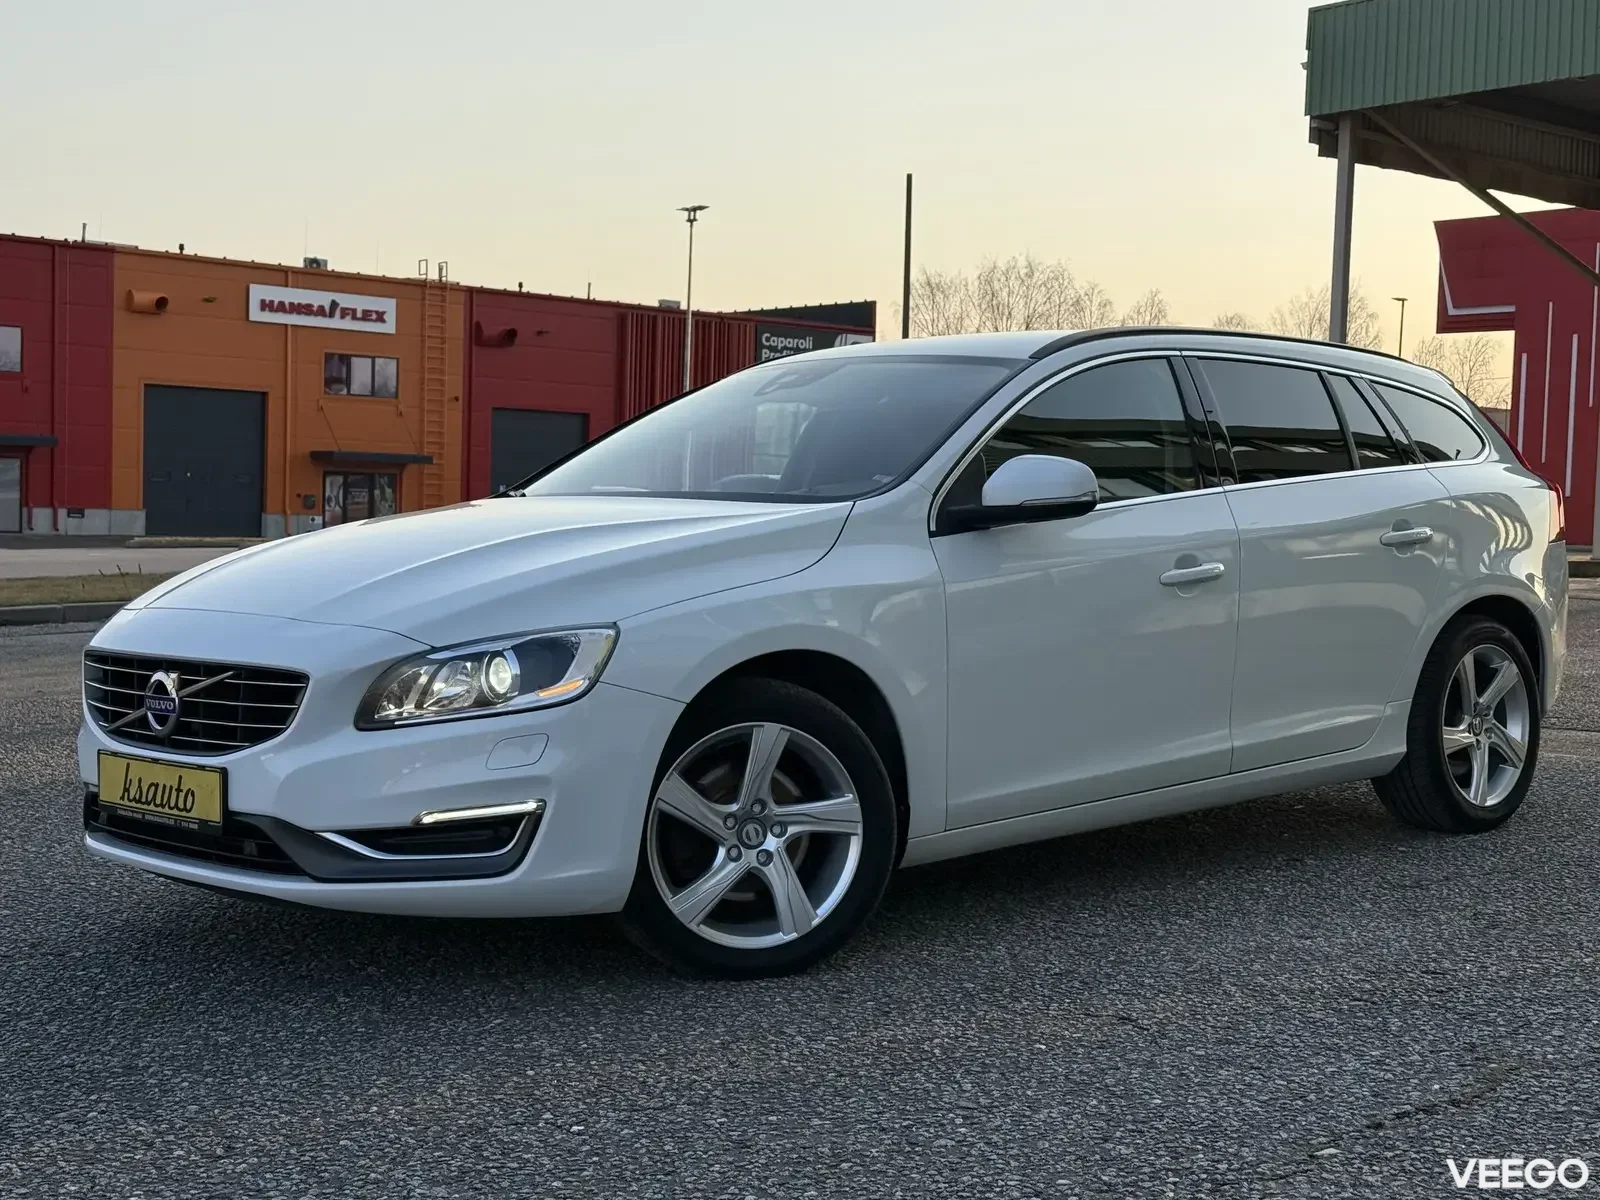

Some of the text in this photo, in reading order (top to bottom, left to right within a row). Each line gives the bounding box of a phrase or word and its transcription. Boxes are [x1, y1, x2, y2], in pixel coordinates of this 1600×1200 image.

[762, 333, 813, 350] Caparoli
[146, 698, 174, 710] VOLVO
[119, 762, 195, 813] ksauto
